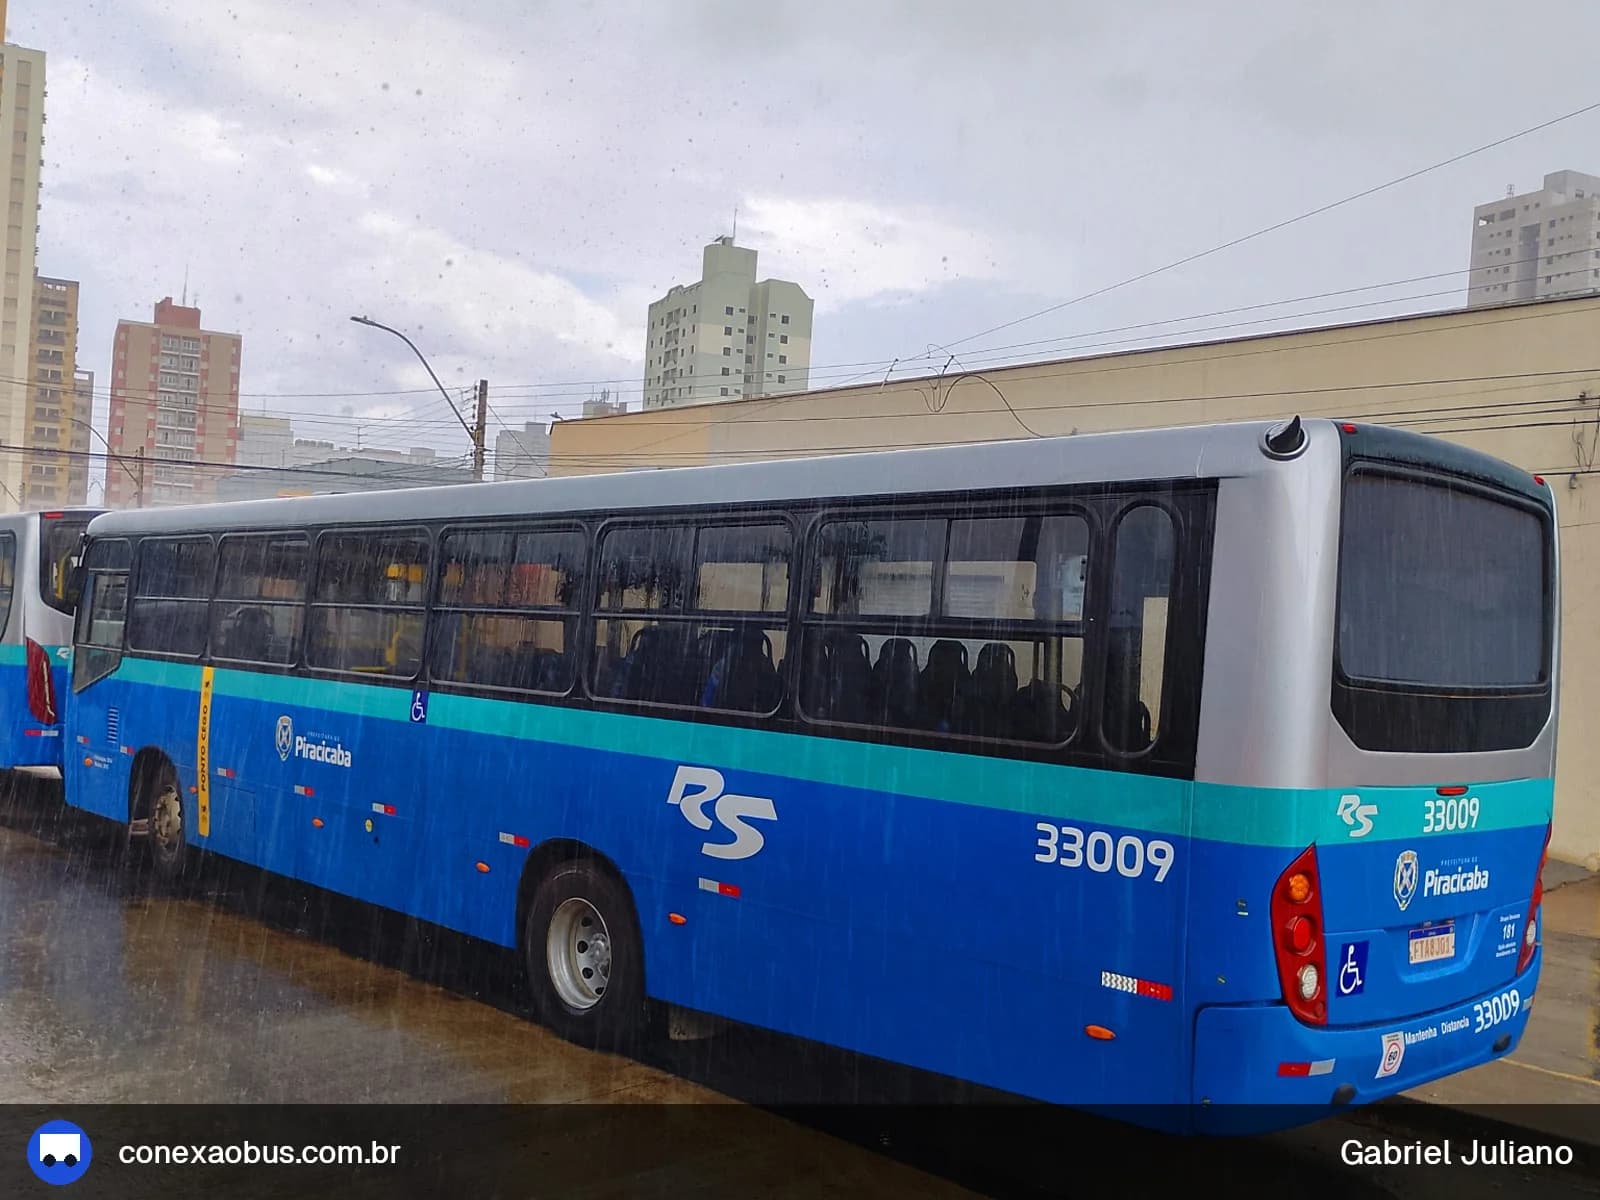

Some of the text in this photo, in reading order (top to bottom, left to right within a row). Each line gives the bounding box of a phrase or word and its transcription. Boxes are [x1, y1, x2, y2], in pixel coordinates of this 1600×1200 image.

[295, 735, 352, 768] Piracicaba
[667, 765, 778, 861] RS
[1336, 794, 1378, 837] RS
[1423, 797, 1480, 833] 33009
[1034, 822, 1175, 883] 33009
[1423, 864, 1489, 898] Piracicaba
[1502, 922, 1516, 940] 181
[1473, 989, 1520, 1034] 33009
[1404, 1016, 1470, 1045] Mantenha Distancia
